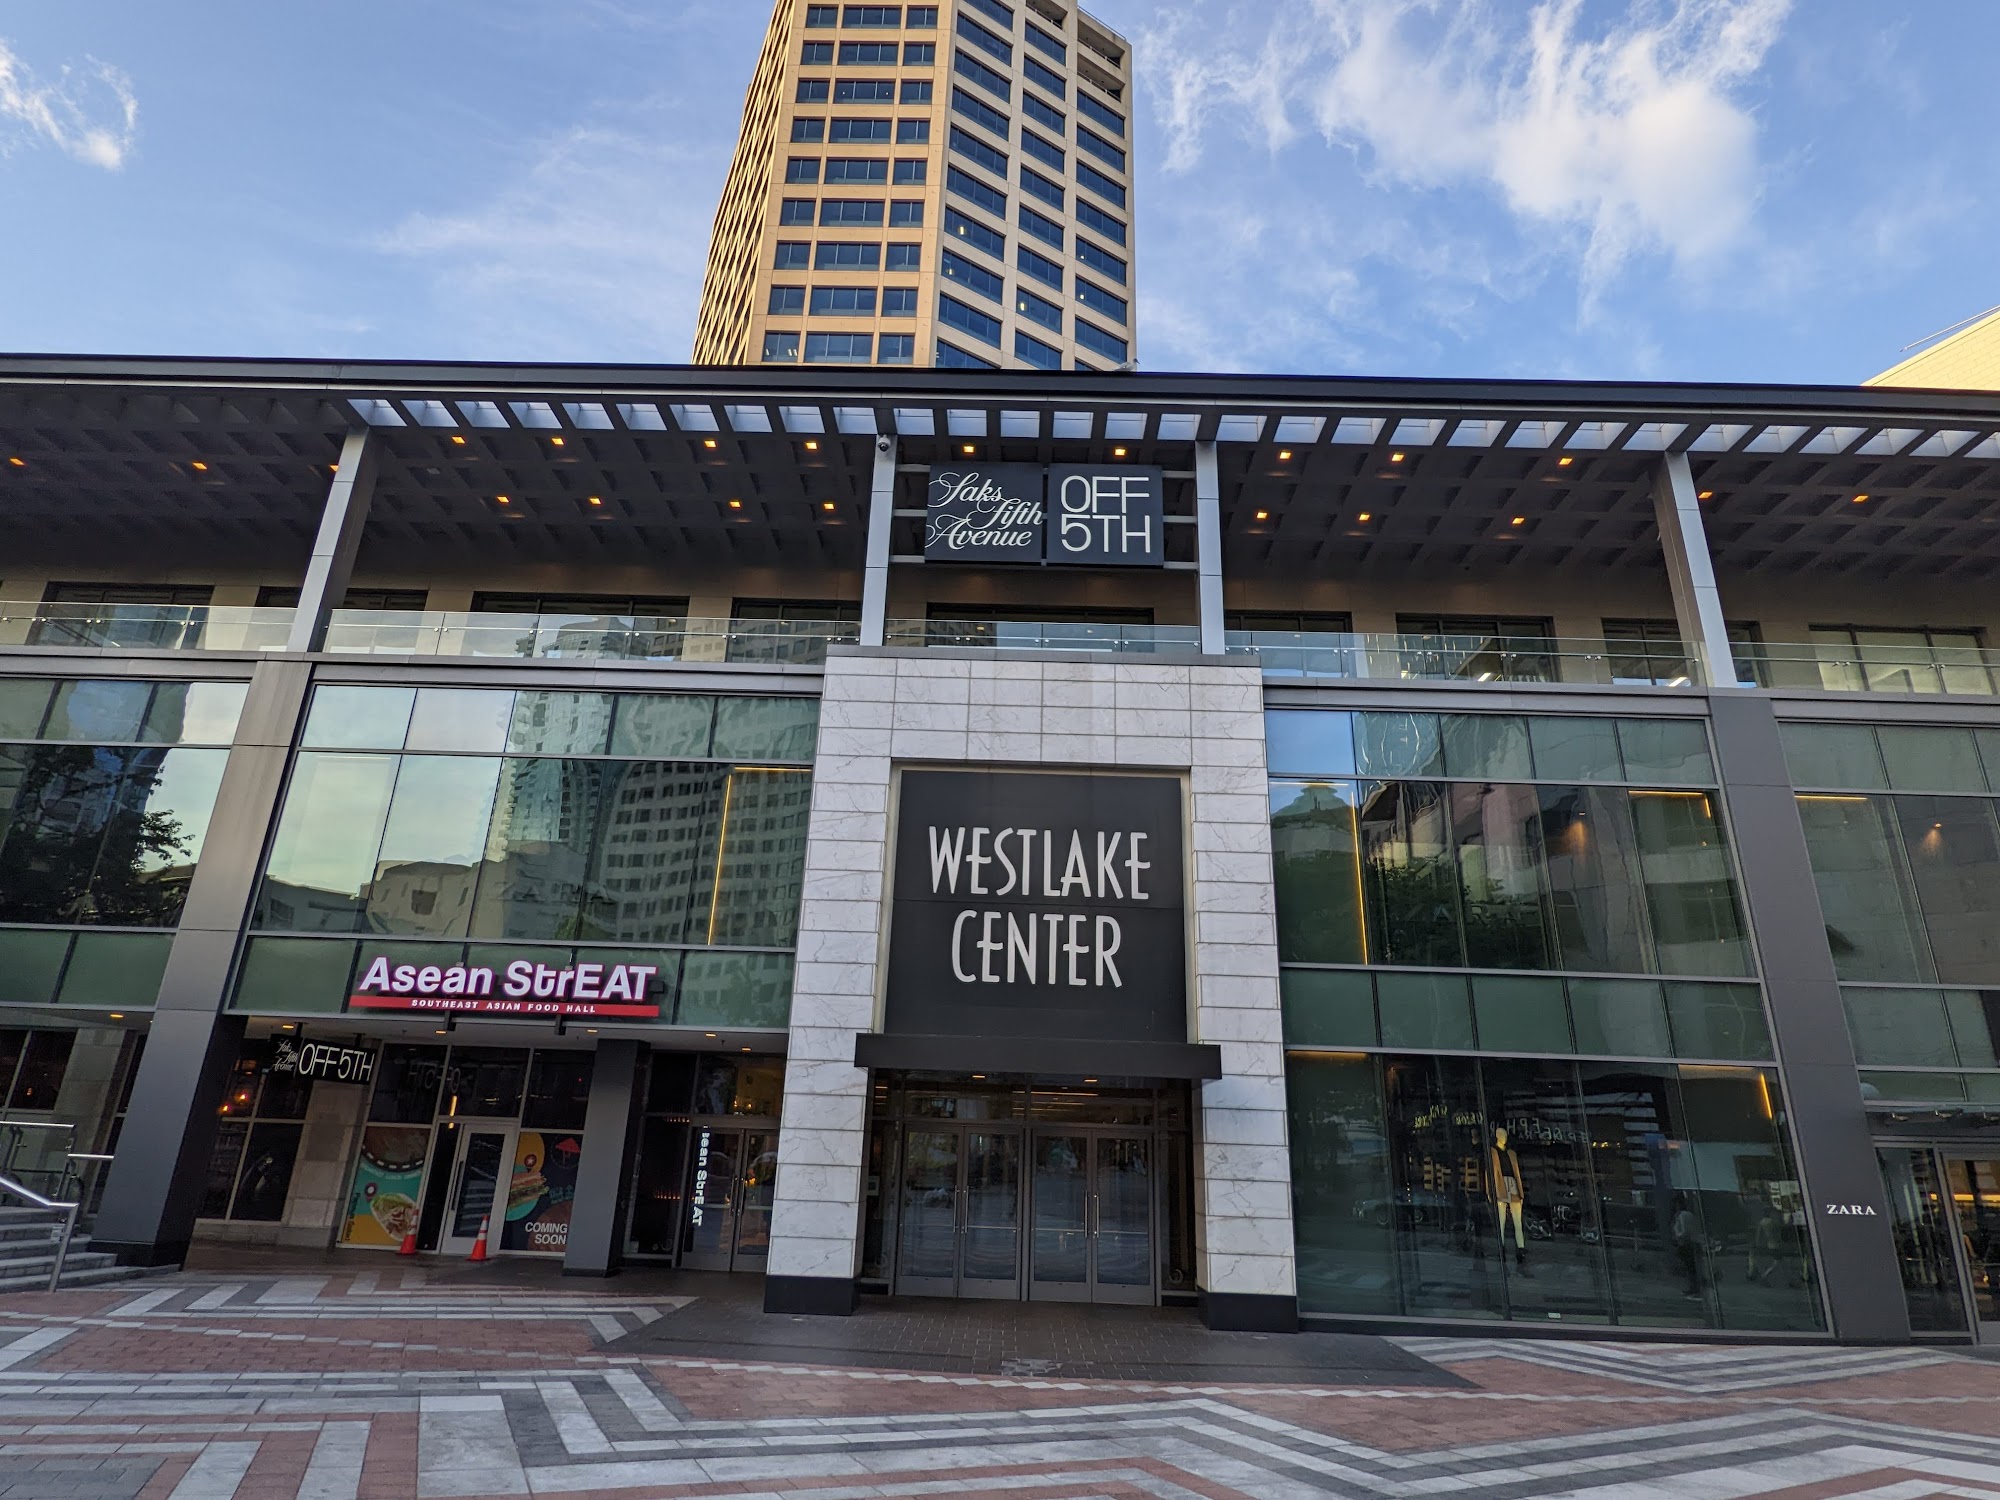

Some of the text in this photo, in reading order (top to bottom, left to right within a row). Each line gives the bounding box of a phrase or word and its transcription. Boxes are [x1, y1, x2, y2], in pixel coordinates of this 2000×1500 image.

[927, 472, 1002, 507] Saks
[1060, 475, 1150, 513] OFF
[924, 514, 1033, 550] Avenue
[1061, 513, 1151, 553] 5TH
[928, 825, 1151, 900] WESTLAKE
[951, 909, 1123, 988] CENTER
[359, 956, 657, 1000] Asean StrEAT
[411, 999, 596, 1013] SOUTHEAST ASIAN FOOD HALL
[299, 1043, 375, 1082] OFF 5TH
[525, 1221, 568, 1234] COMING
[1826, 1204, 1877, 1216] ZARA
[534, 1233, 567, 1245] SOON
